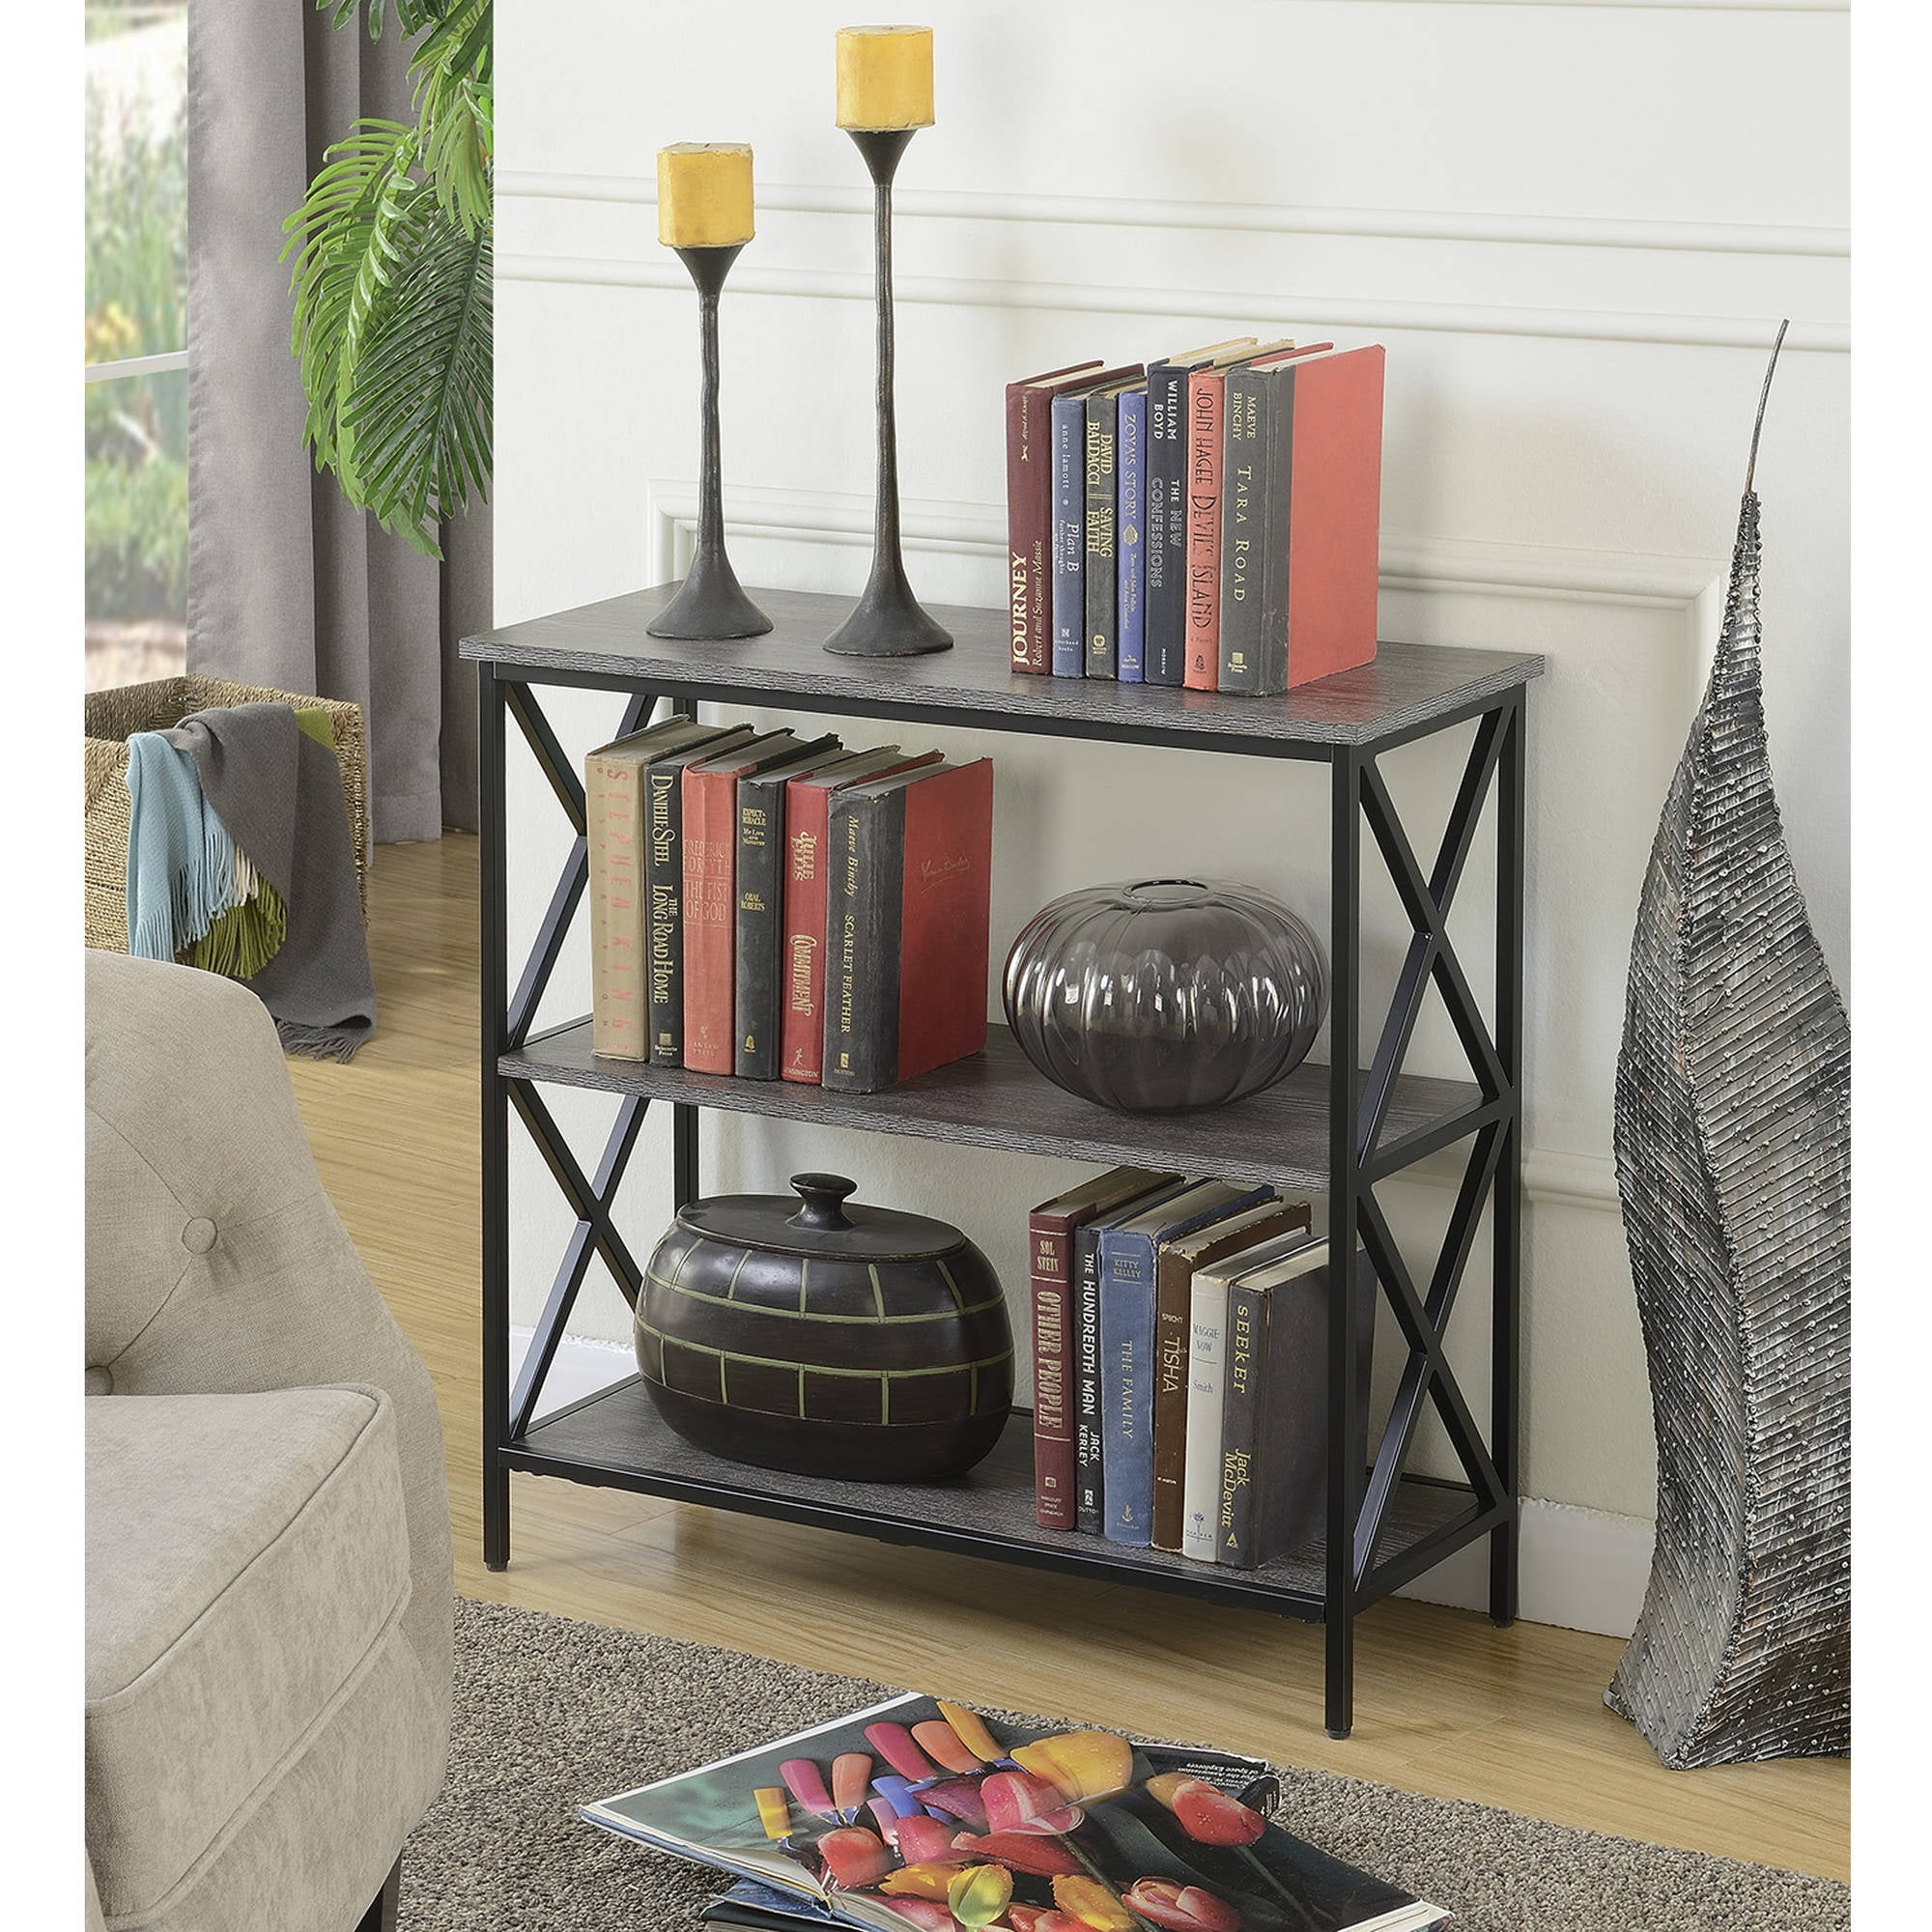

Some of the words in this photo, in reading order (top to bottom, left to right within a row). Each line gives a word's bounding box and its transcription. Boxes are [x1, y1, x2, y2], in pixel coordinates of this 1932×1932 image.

[1153, 404, 1164, 440] BOYD
[1166, 380, 1178, 440] WILLIAM
[1195, 387, 1215, 432] JOHN
[1232, 392, 1243, 440] BINCHY
[1246, 396, 1256, 439] MAEVE
[1087, 421, 1100, 486] BALDACCI
[1100, 434, 1113, 474] DAVID
[1124, 413, 1137, 466] ZOYA'S
[1062, 454, 1070, 489] lamott
[1194, 437, 1213, 486] HAGEE
[1124, 470, 1137, 520] STORY
[1171, 480, 1180, 502] THE
[1236, 466, 1252, 524] TARA
[1066, 524, 1079, 554] Plan
[1087, 510, 1099, 553] FAITH
[1098, 507, 1113, 558] SAVING
[1151, 477, 1163, 588] CONFESSIONS
[1170, 509, 1182, 548] NEW
[1033, 541, 1041, 576] Massie
[1066, 560, 1079, 573] B
[1234, 539, 1250, 603] ROAD
[1011, 552, 1029, 666] JOURNEY
[1033, 577, 1043, 615] Suzanne
[1192, 564, 1217, 628] ISLAND
[1034, 617, 1042, 634] and
[1033, 636, 1043, 667] Robert
[651, 774, 672, 827] DANIELLE
[607, 768, 633, 911] STEPHEN
[651, 826, 675, 867] STEEL
[846, 815, 859, 853] Maeve
[790, 838, 805, 881] ELLIS
[799, 832, 817, 879] JULIE
[685, 879, 703, 900] THE
[707, 881, 728, 901] FIST
[845, 857, 859, 897] Binchy
[651, 884, 673, 921] LONG
[668, 897, 678, 916] THE
[686, 899, 700, 919] OF
[700, 901, 727, 922] GOD
[652, 922, 673, 959] ROAD
[842, 915, 855, 970] SCARLET
[611, 936, 634, 1031] KING
[652, 959, 673, 1004] HOME
[789, 933, 818, 1016] COMMITMENT
[840, 976, 853, 1034] FEATHER
[1037, 1257, 1059, 1272] STEIN
[1039, 1240, 1055, 1256] SOL
[1085, 1253, 1094, 1274] THE
[1114, 1259, 1139, 1269] KITTY
[1113, 1267, 1142, 1278] KELLEY
[1037, 1291, 1062, 1352] OTHER
[1082, 1280, 1095, 1374] HUNDREDTH
[1122, 1341, 1133, 1371] THE
[1037, 1357, 1063, 1429] PEOPLE
[1082, 1378, 1095, 1415] MAN
[1193, 1379, 1213, 1393] Smith
[1122, 1378, 1134, 1438] FAMILY
[1078, 1424, 1090, 1467] KERLEY
[1090, 1431, 1100, 1461] JACK
[1235, 1448, 1251, 1486] Jack
[1221, 1452, 1238, 1528] McDevitt
[1186, 1762, 1225, 1773] Explorers
[1225, 1767, 1249, 1776] Space
